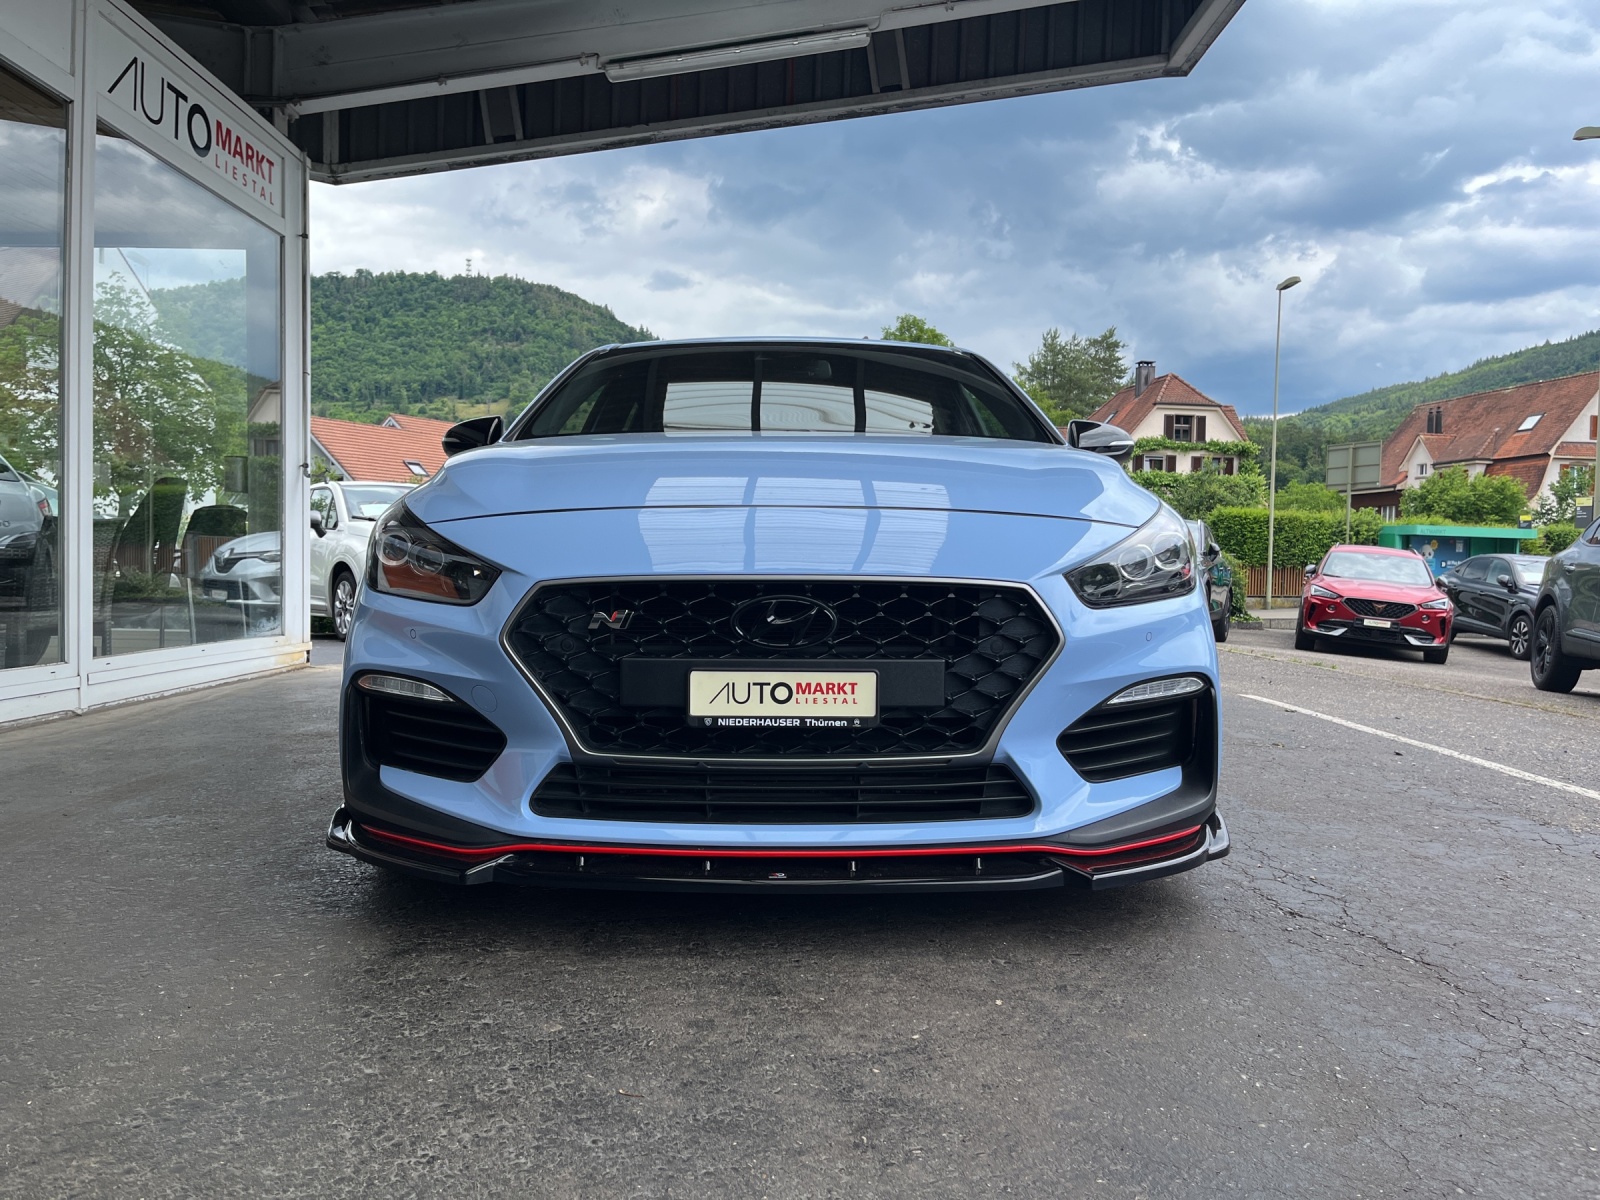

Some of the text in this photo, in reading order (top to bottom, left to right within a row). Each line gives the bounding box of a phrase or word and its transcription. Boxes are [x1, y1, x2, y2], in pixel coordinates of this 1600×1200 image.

[107, 56, 275, 185] AUTO MARKT
[215, 153, 275, 206] LIESTAL
[709, 682, 858, 705] AUTO MARKT
[795, 697, 858, 705] LIESTAL
[717, 718, 848, 727] NIEDERHAUSER Thürnen
